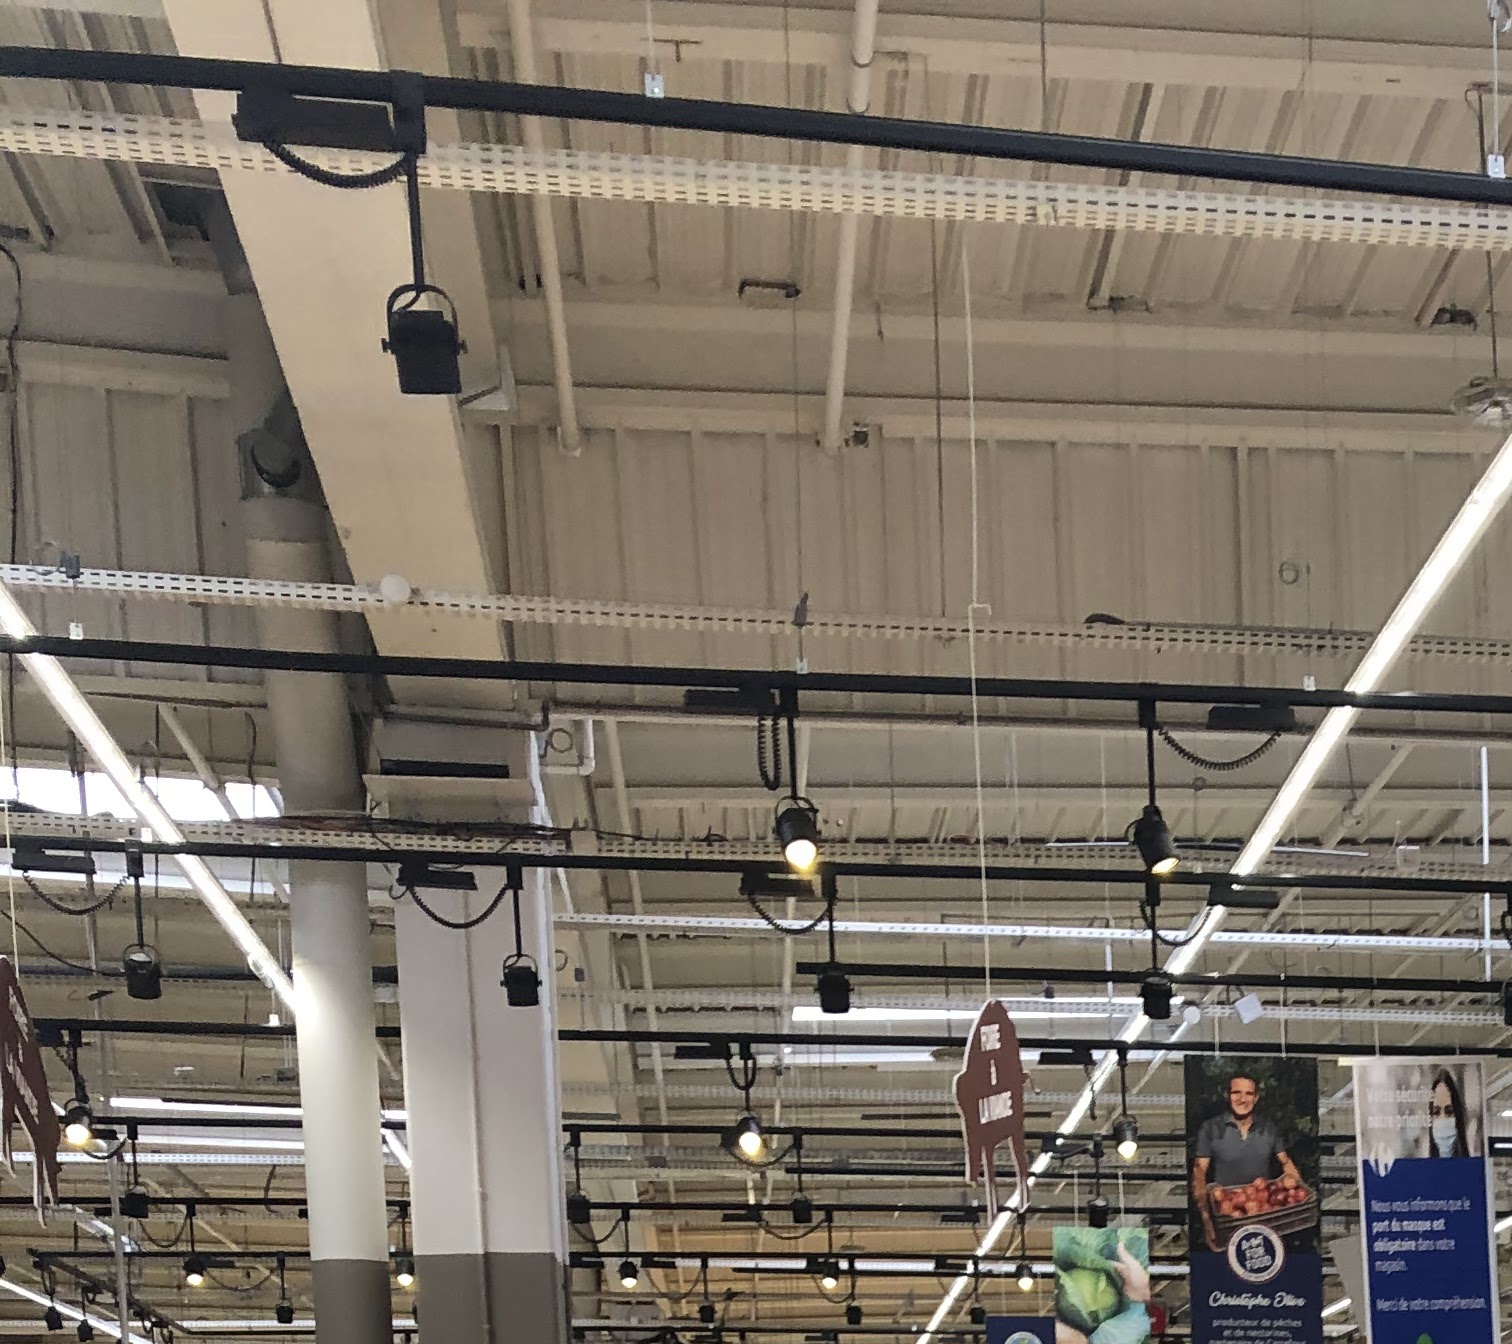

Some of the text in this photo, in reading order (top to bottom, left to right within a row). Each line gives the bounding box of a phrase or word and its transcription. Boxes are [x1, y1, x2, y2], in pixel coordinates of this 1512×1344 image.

[1367, 1088, 1395, 1104] Votre
[1367, 1115, 1395, 1129] notre
[1372, 1218, 1389, 1235] port
[1402, 1219, 1431, 1234] masque
